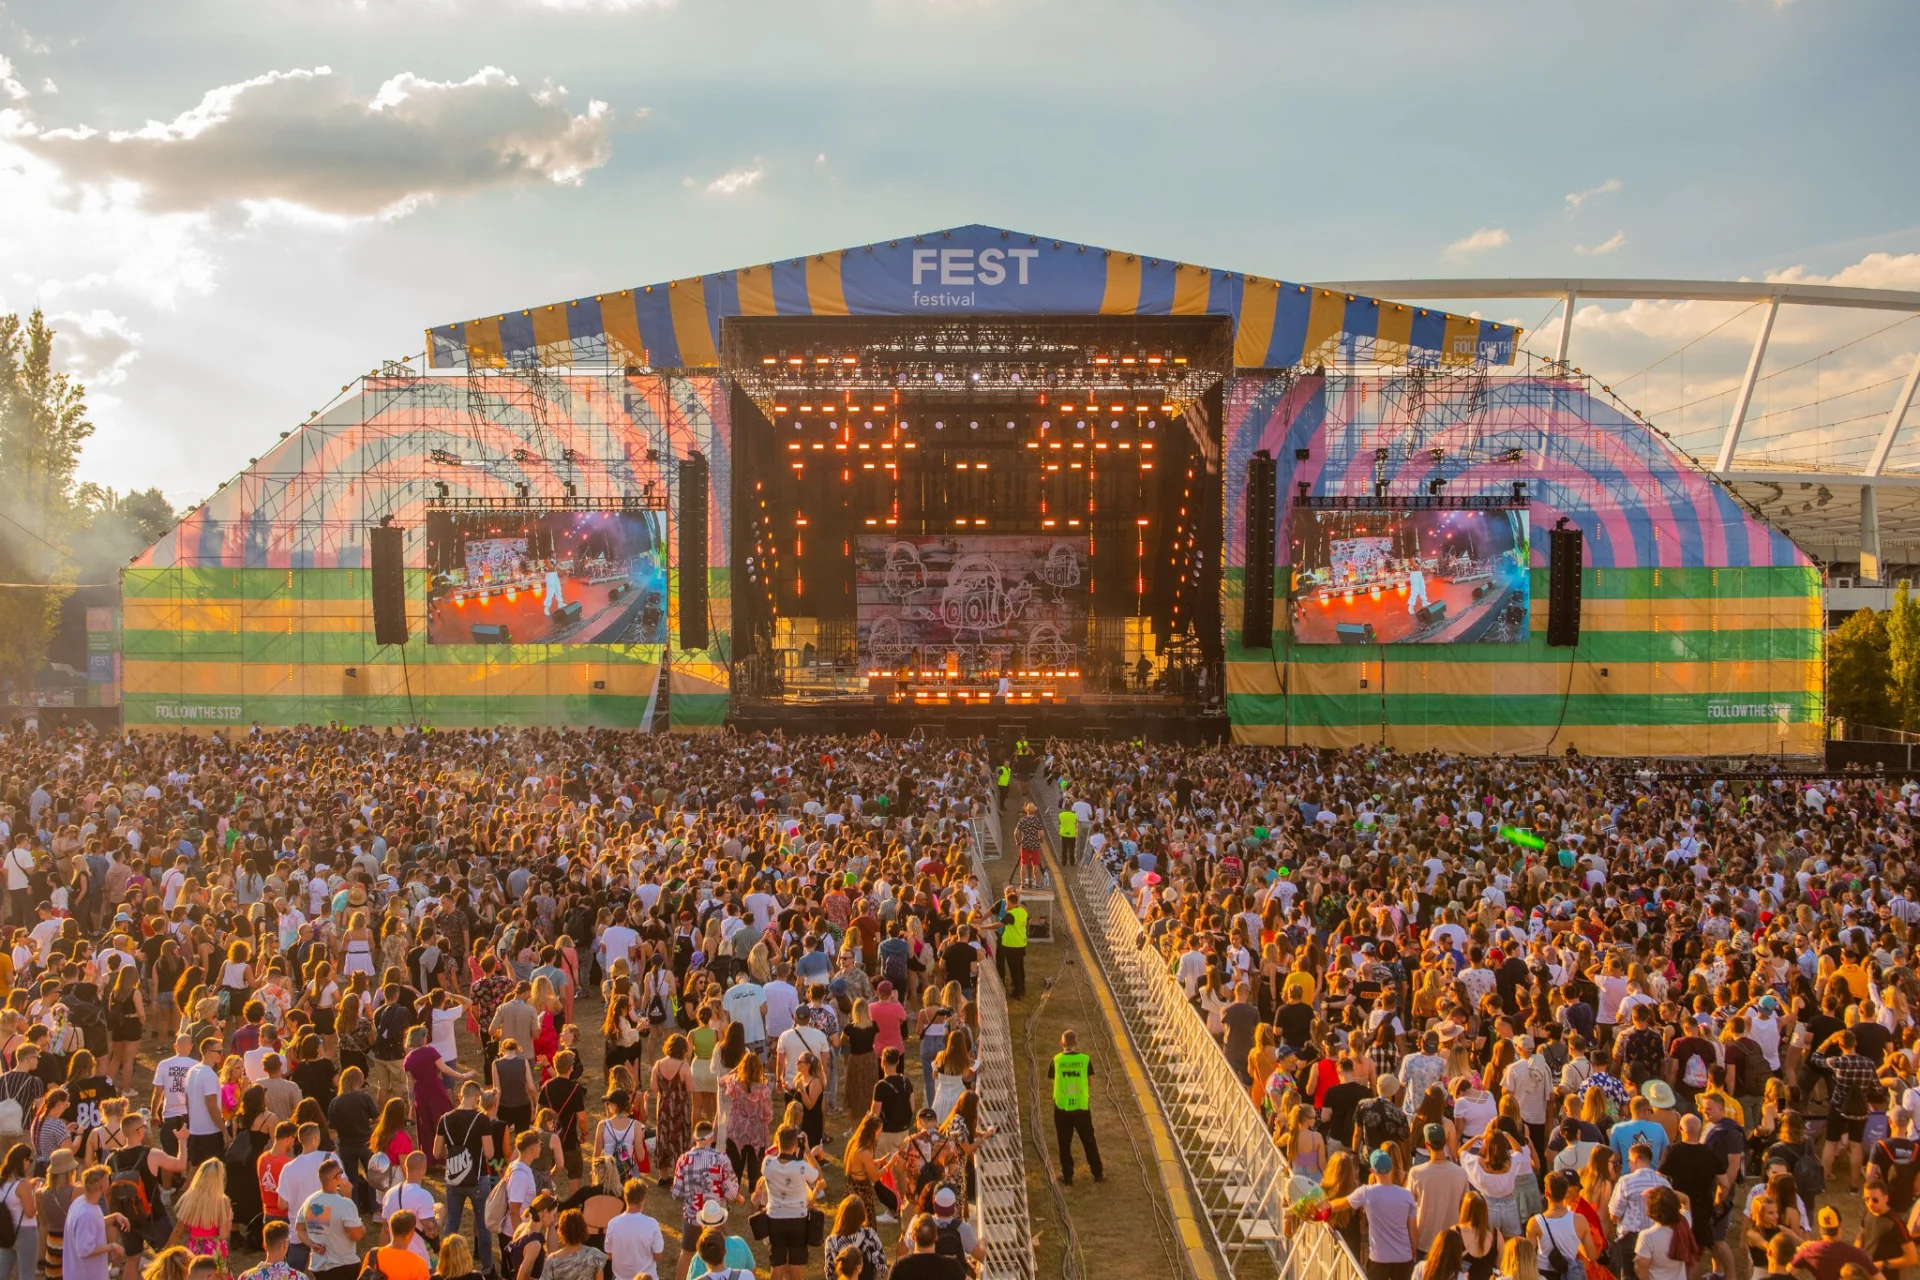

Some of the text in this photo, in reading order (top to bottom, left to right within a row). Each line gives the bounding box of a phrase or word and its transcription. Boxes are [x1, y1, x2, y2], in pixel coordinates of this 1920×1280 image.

[912, 248, 1039, 286] FEST
[912, 290, 975, 306] festival
[77, 1101, 102, 1129] 86
